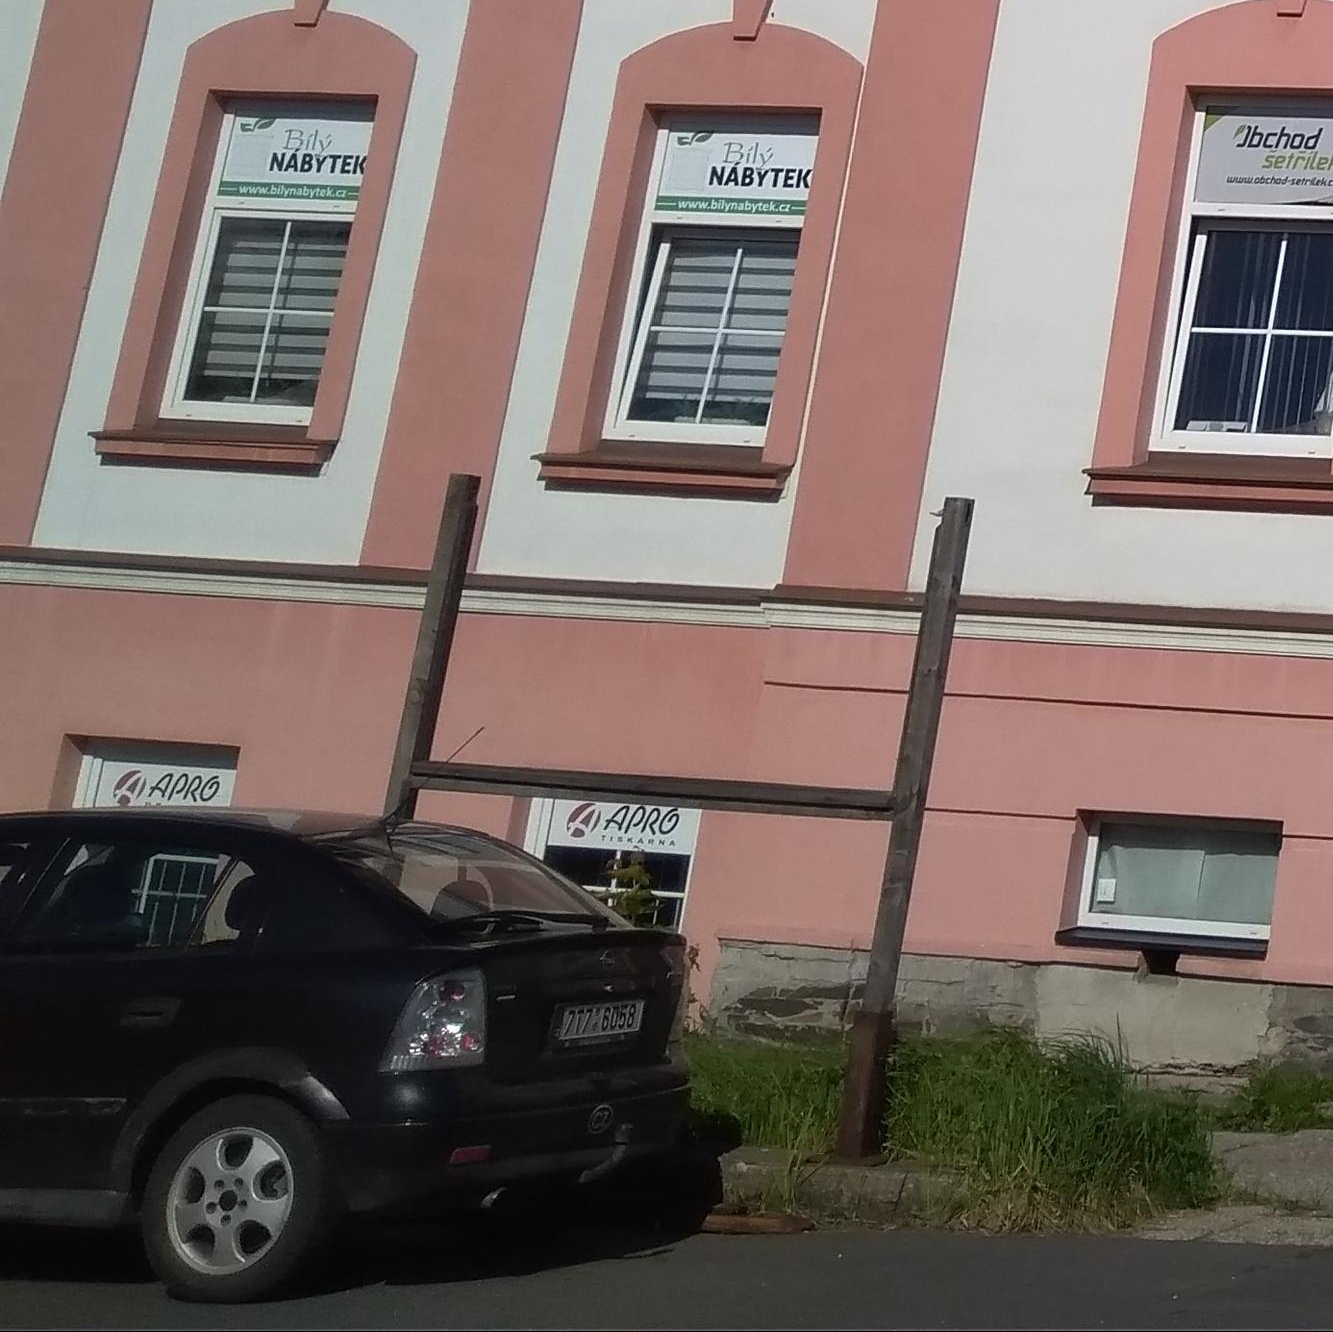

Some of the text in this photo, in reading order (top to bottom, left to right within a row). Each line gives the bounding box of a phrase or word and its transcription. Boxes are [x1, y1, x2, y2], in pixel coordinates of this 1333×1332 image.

[283, 128, 332, 154] Bílý
[269, 148, 367, 174] NÁBYTEK
[723, 142, 773, 168] Bílý
[709, 162, 813, 188] NÁBYTEK
[239, 185, 346, 198] www.bilynabytek.cz
[678, 199, 790, 212] www.bilynabytek.cz
[149, 773, 220, 802] APRO
[603, 805, 680, 835] APRO
